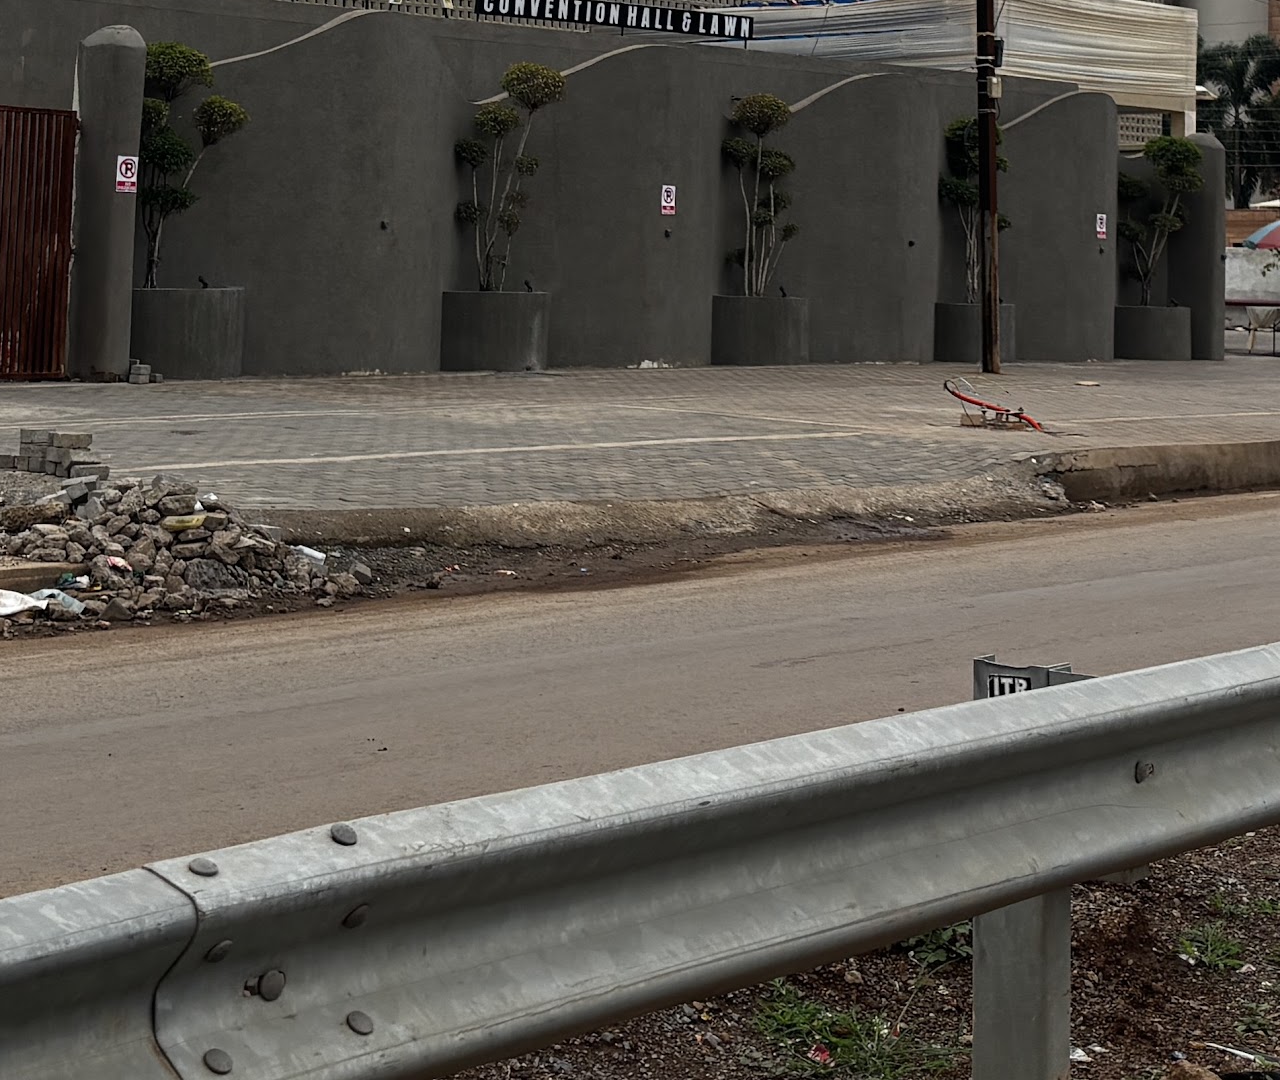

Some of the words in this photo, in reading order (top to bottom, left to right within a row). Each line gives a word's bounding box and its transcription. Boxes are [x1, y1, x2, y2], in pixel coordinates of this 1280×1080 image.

[627, 5, 674, 31] HALL
[681, 12, 692, 32] &
[698, 13, 751, 38] LAWN
